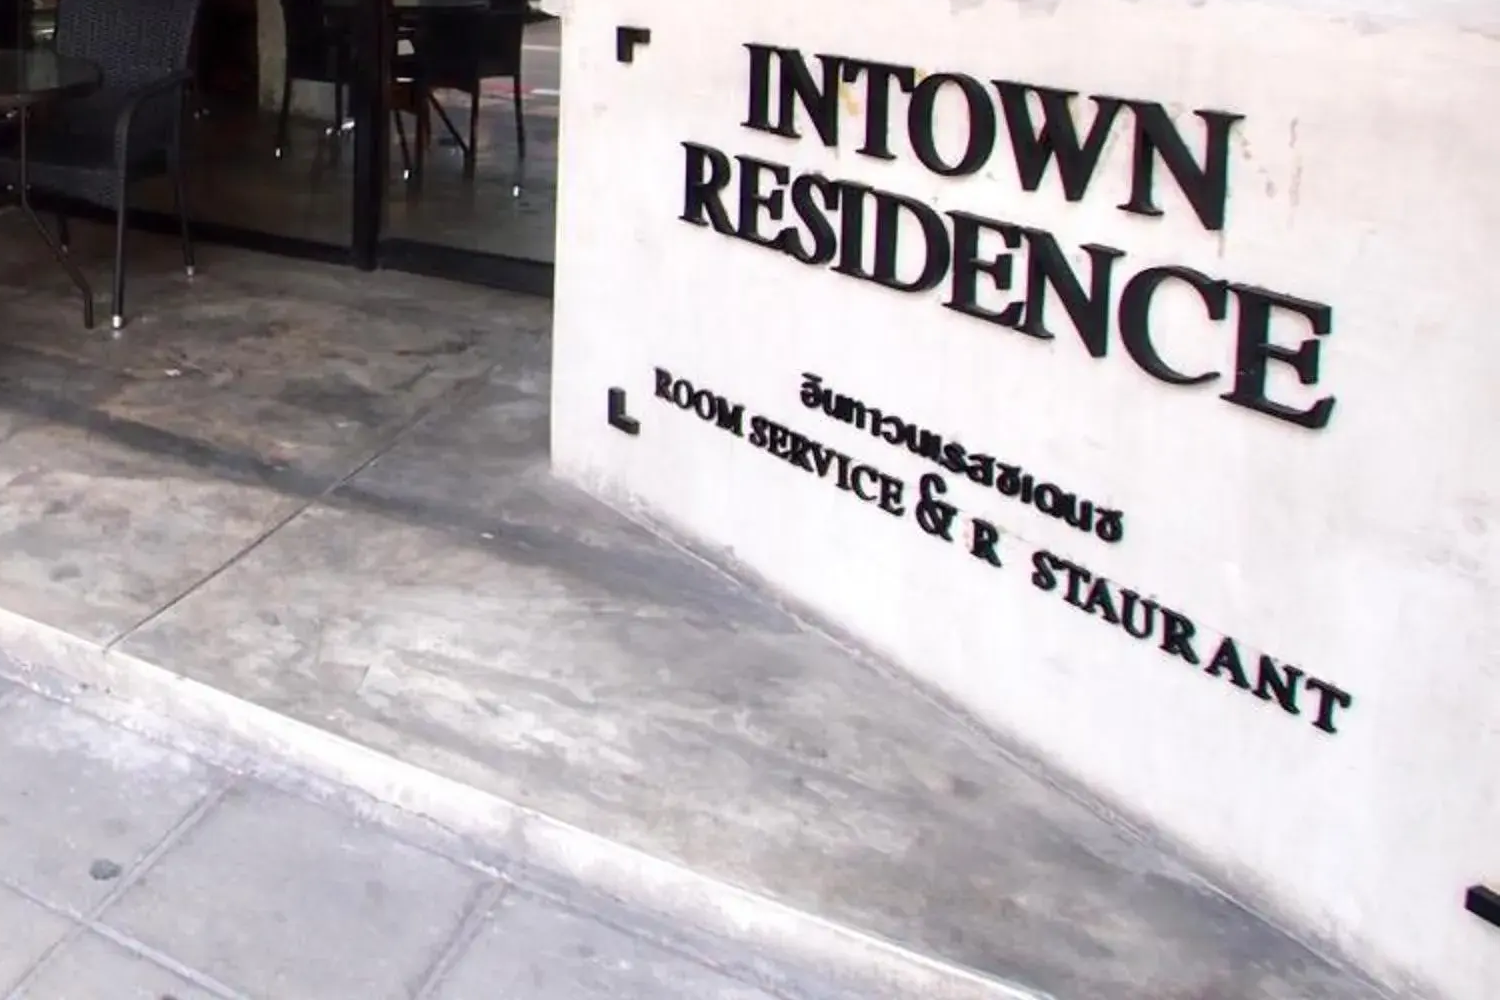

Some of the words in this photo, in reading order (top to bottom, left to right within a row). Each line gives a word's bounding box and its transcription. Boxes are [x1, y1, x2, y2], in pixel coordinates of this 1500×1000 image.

[740, 42, 1246, 232] INTOWN
[679, 141, 1337, 431] RESIDENCE
[654, 366, 746, 438] ROOM
[748, 414, 906, 518] SERVICE
[914, 472, 959, 543] &
